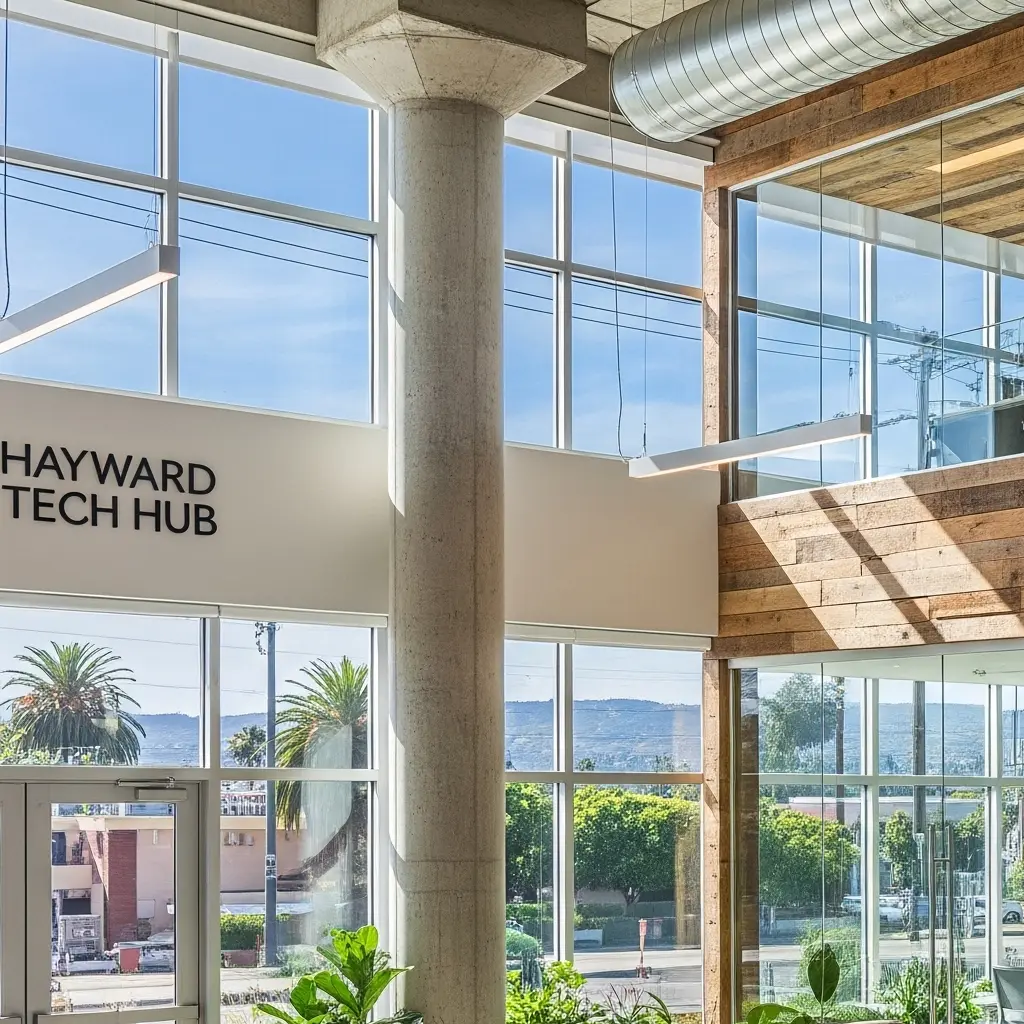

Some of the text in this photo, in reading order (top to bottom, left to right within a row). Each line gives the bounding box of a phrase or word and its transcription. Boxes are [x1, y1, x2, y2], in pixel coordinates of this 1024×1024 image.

[1, 440, 217, 496] HAYWARD
[1, 484, 218, 536] TECH HUB
